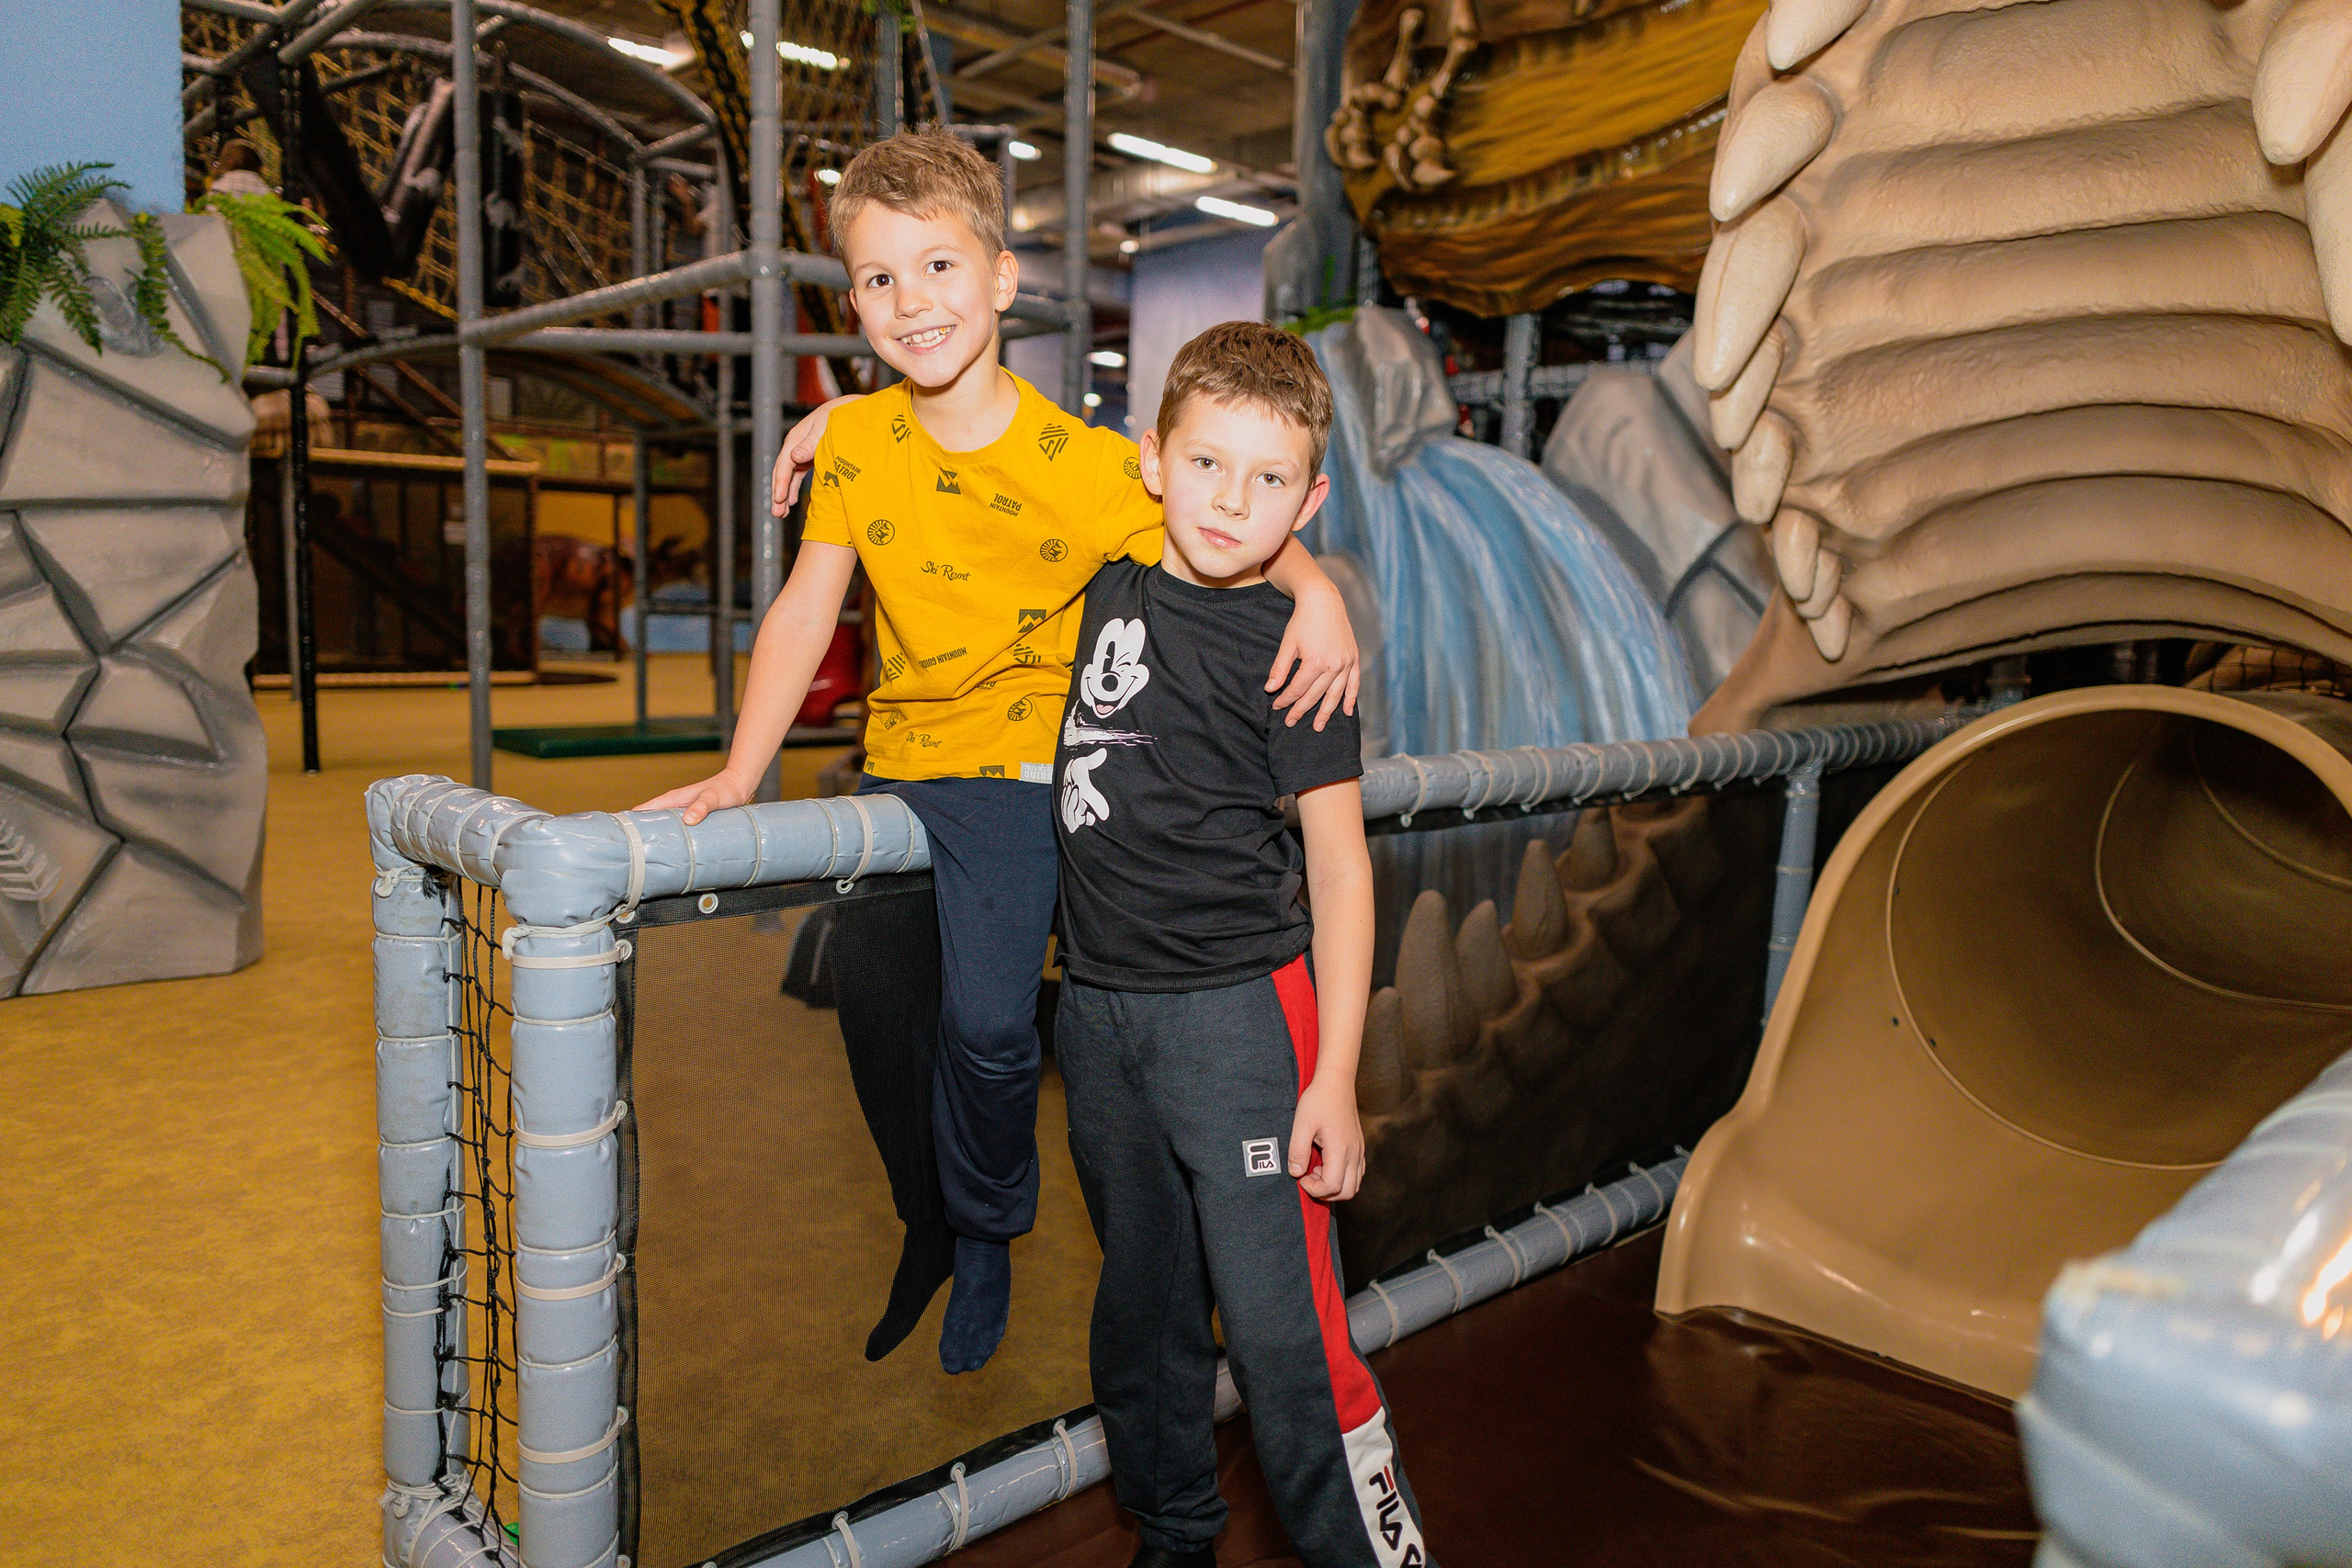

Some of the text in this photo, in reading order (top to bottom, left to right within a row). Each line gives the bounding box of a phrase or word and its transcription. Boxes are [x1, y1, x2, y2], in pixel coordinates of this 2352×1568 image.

[835, 456, 862, 474] MOUNTAIN
[989, 502, 1019, 517] MOUNTAIN
[993, 493, 1023, 512] PATROL
[921, 560, 972, 581] Ski Resort
[936, 646, 967, 664] MOUNTAIN
[1250, 1144, 1274, 1170] FILA
[1369, 1465, 1403, 1551] FILA
